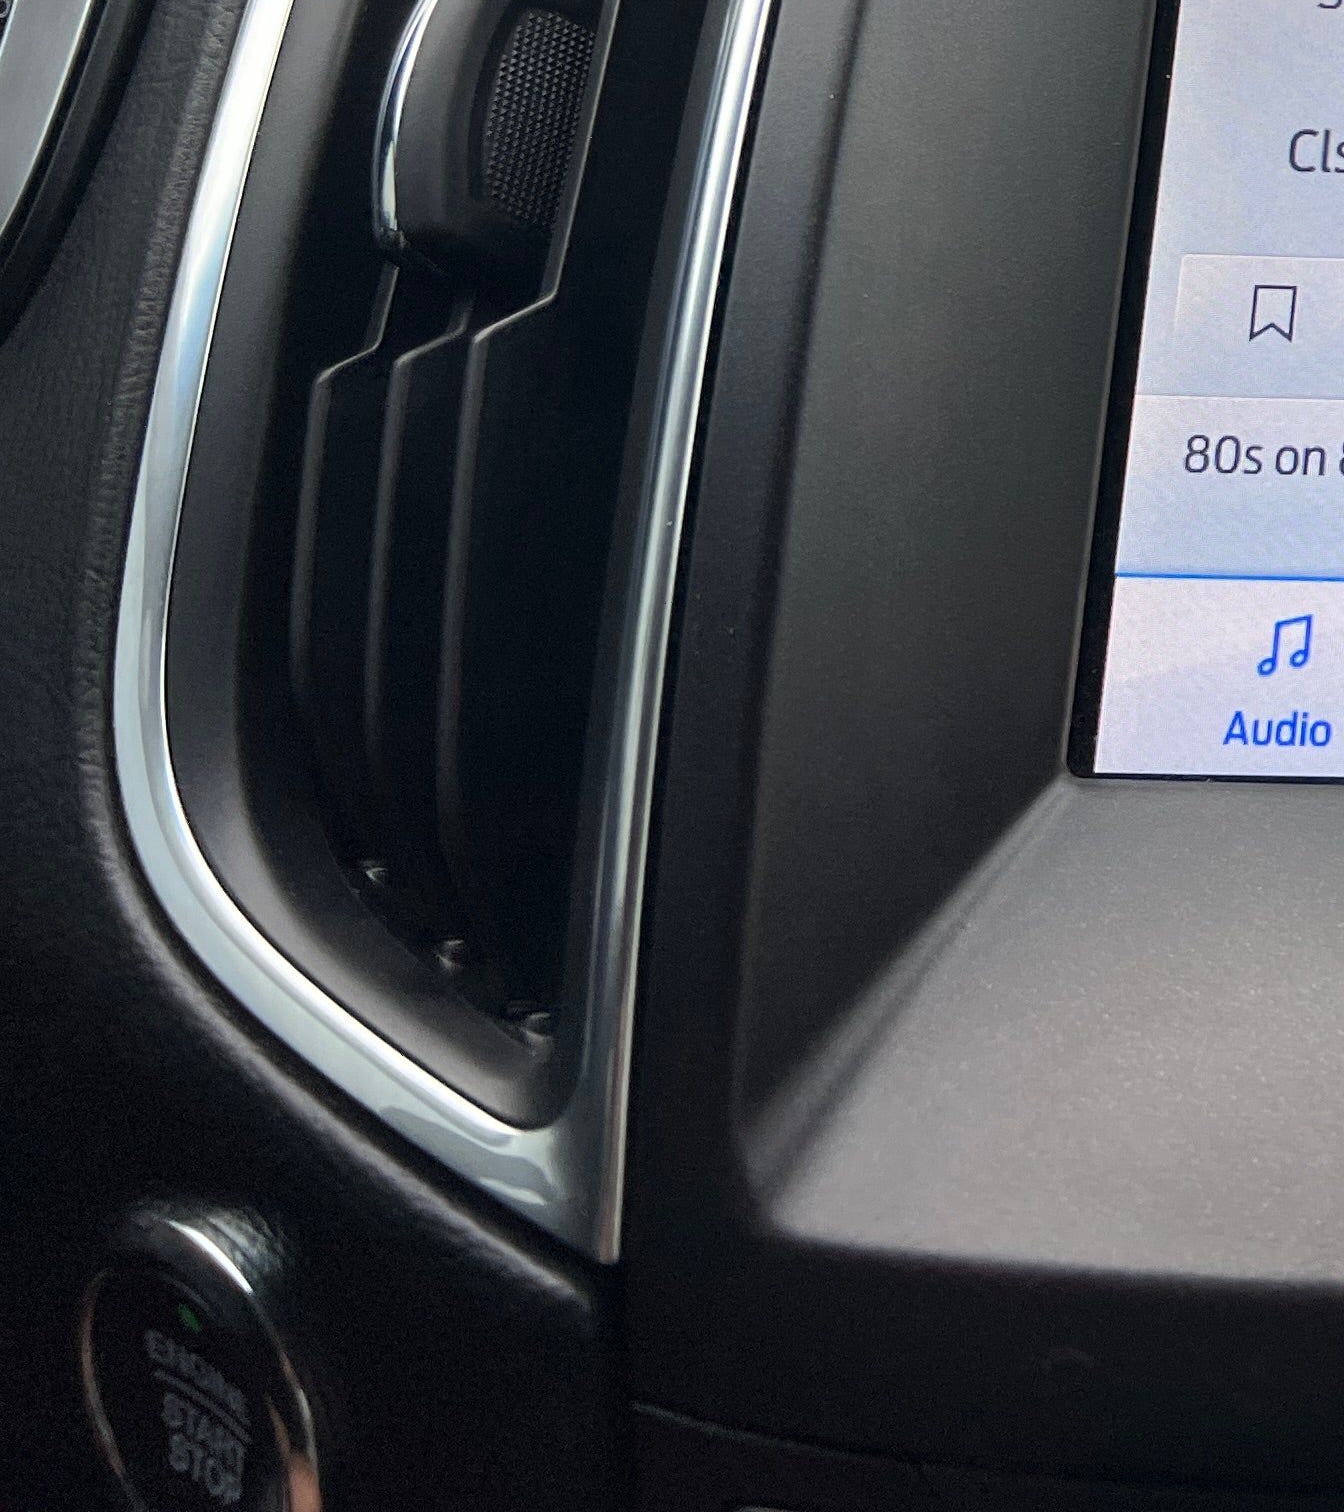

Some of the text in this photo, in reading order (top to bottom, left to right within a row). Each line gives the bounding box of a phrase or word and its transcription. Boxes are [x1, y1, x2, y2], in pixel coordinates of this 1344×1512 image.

[1183, 433, 1264, 476] 80s
[1274, 445, 1327, 477] on
[1221, 709, 1332, 748] Audio
